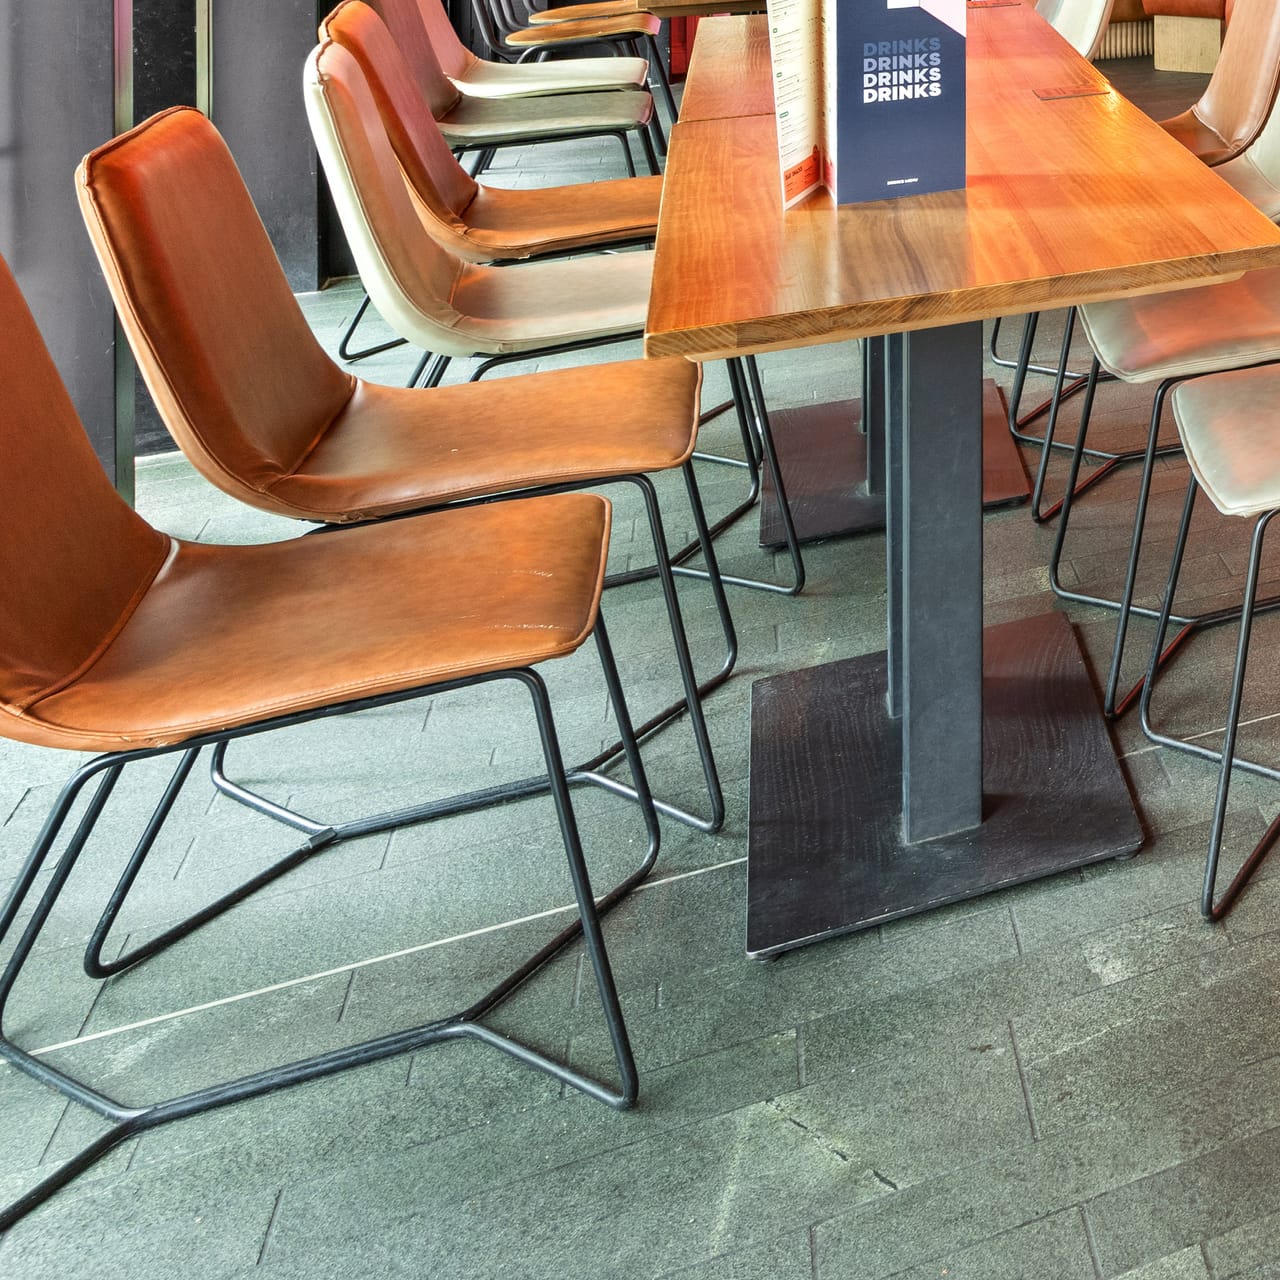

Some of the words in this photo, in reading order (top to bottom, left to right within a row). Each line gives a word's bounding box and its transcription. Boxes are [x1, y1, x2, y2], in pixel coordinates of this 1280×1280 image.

[863, 37, 941, 56] DRINKS
[863, 52, 941, 72] DRINKS
[863, 68, 942, 88] DRINKS
[863, 82, 942, 104] DRINKS
